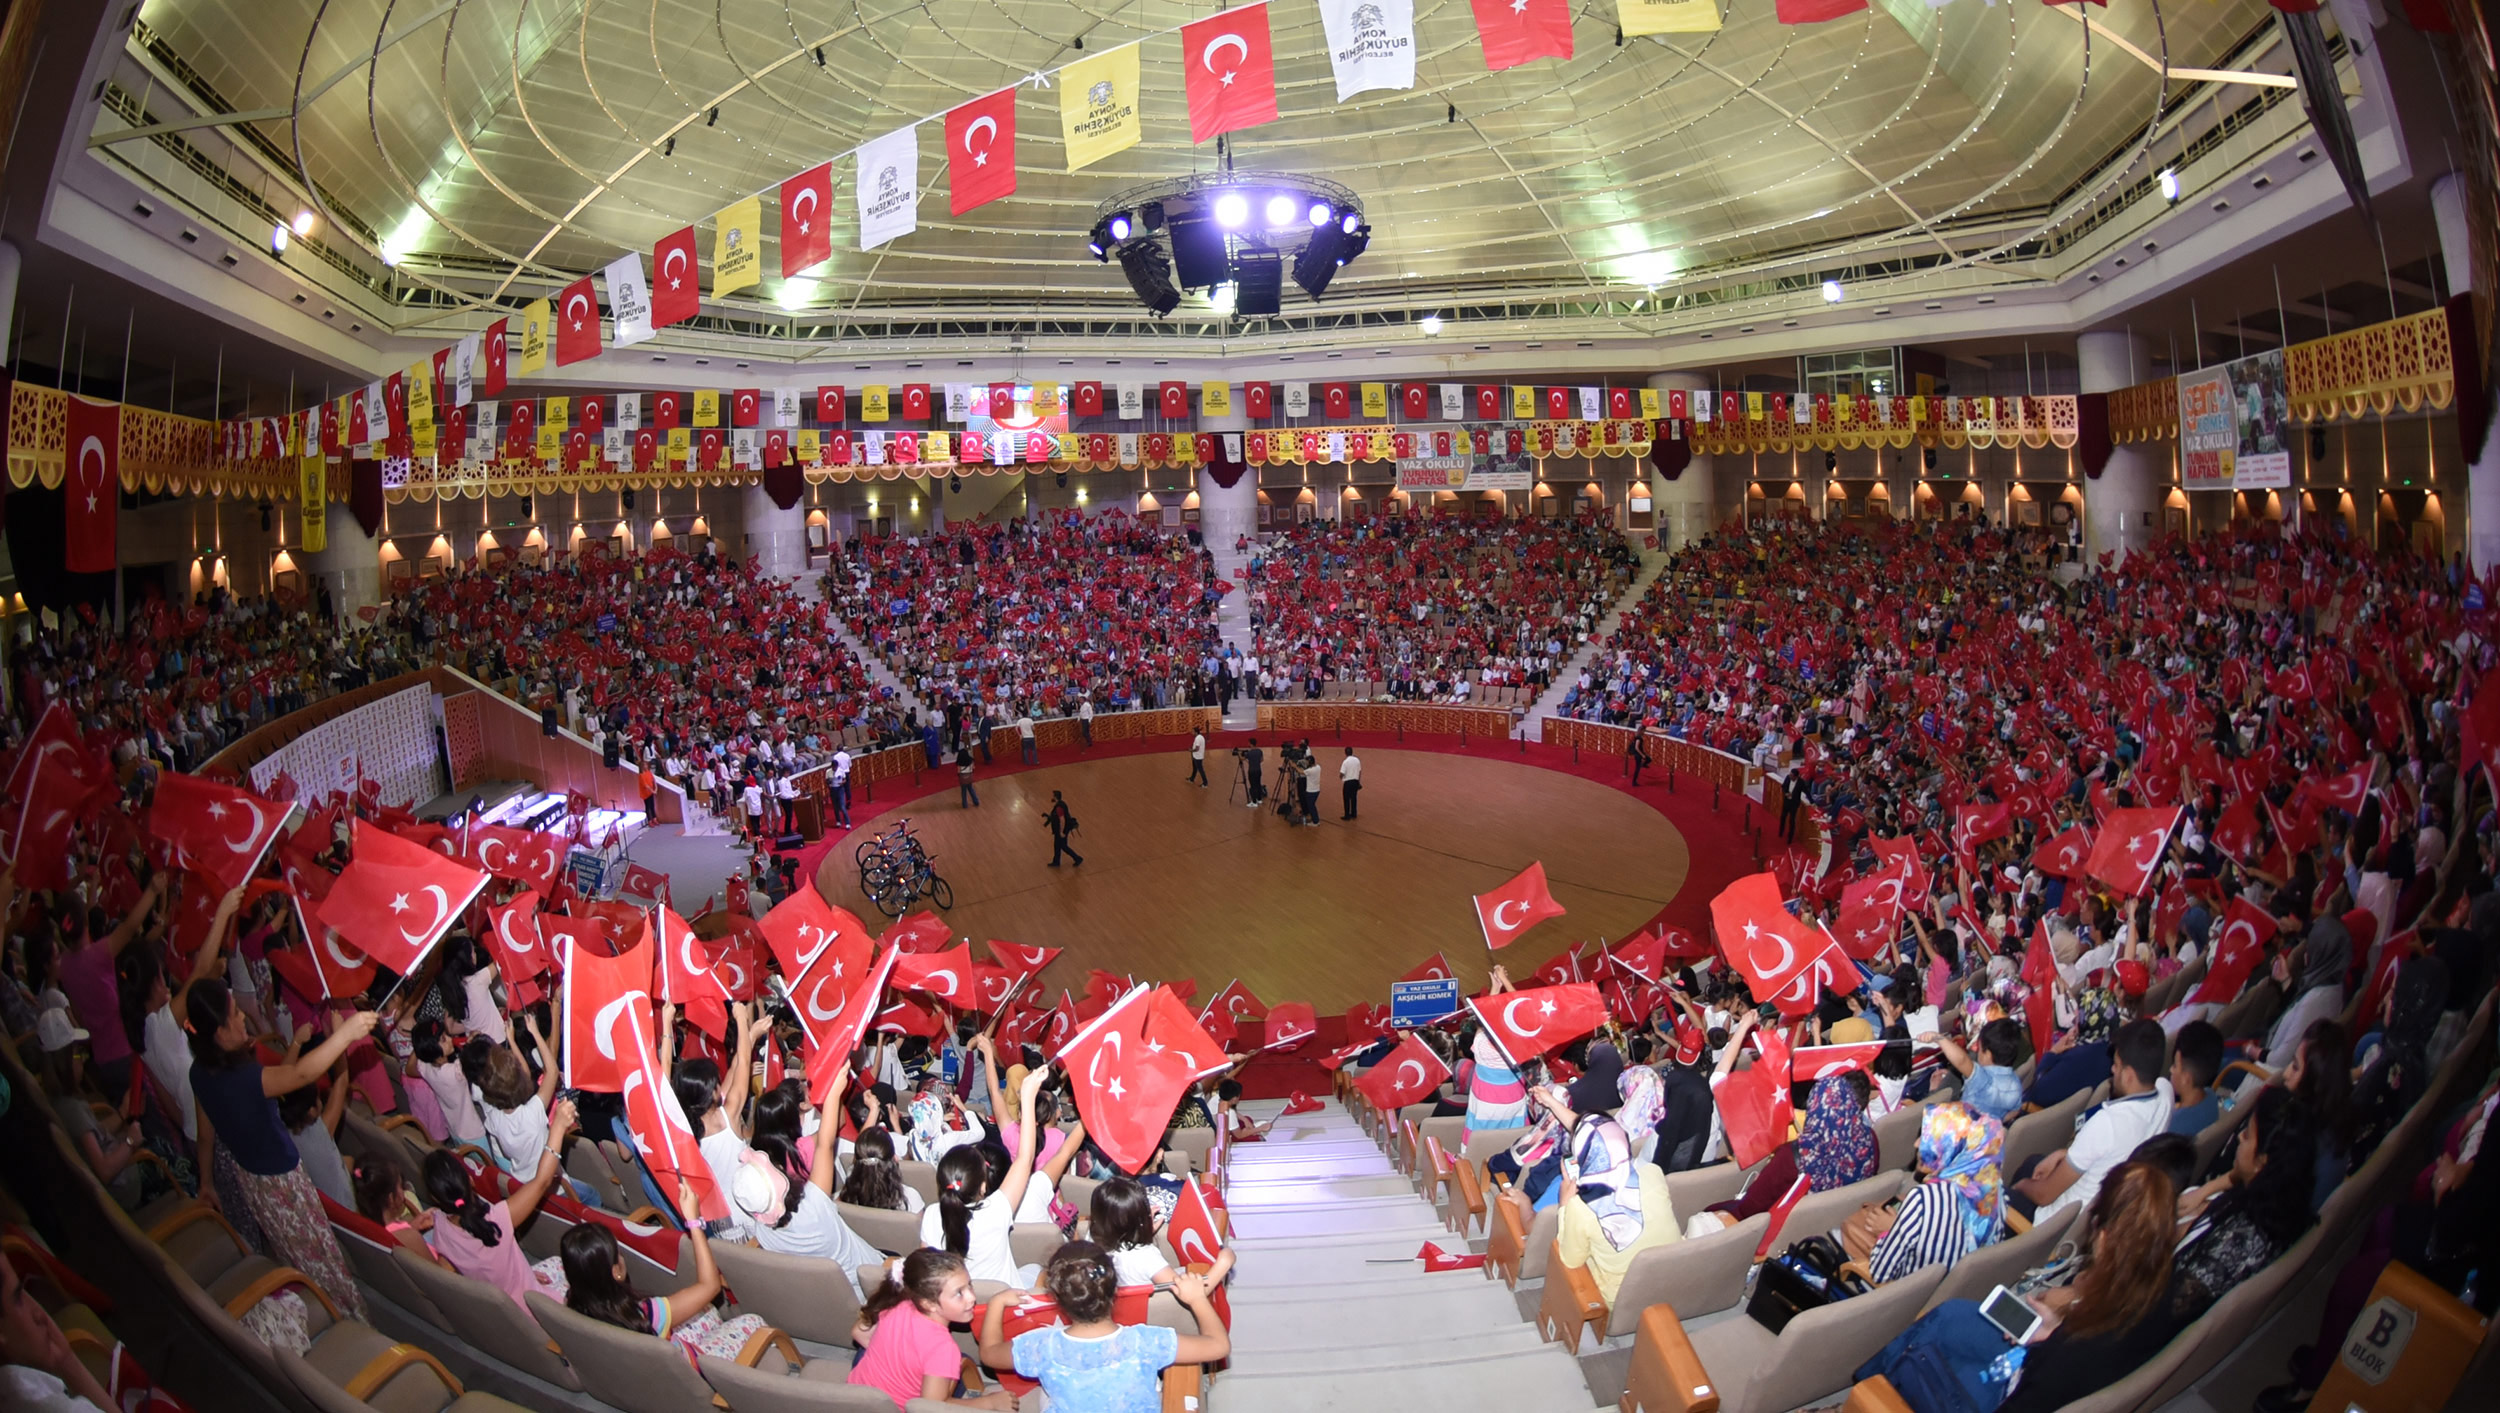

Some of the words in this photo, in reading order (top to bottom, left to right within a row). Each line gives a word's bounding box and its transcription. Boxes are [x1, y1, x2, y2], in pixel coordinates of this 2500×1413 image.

[2186, 436, 2201, 451] YAZ
[2203, 432, 2233, 449] OKULU
[1402, 461, 1422, 469] YAZ
[1426, 460, 1464, 468] OKULU
[1402, 469, 1447, 477] TURNUVA
[2187, 465, 2220, 479] HAFTASI
[1397, 994, 1426, 1002] AKŞEHİR
[1428, 992, 1452, 1000] KOMEK
[2366, 1307, 2398, 1348] B
[2350, 1341, 2386, 1374] BLOK
